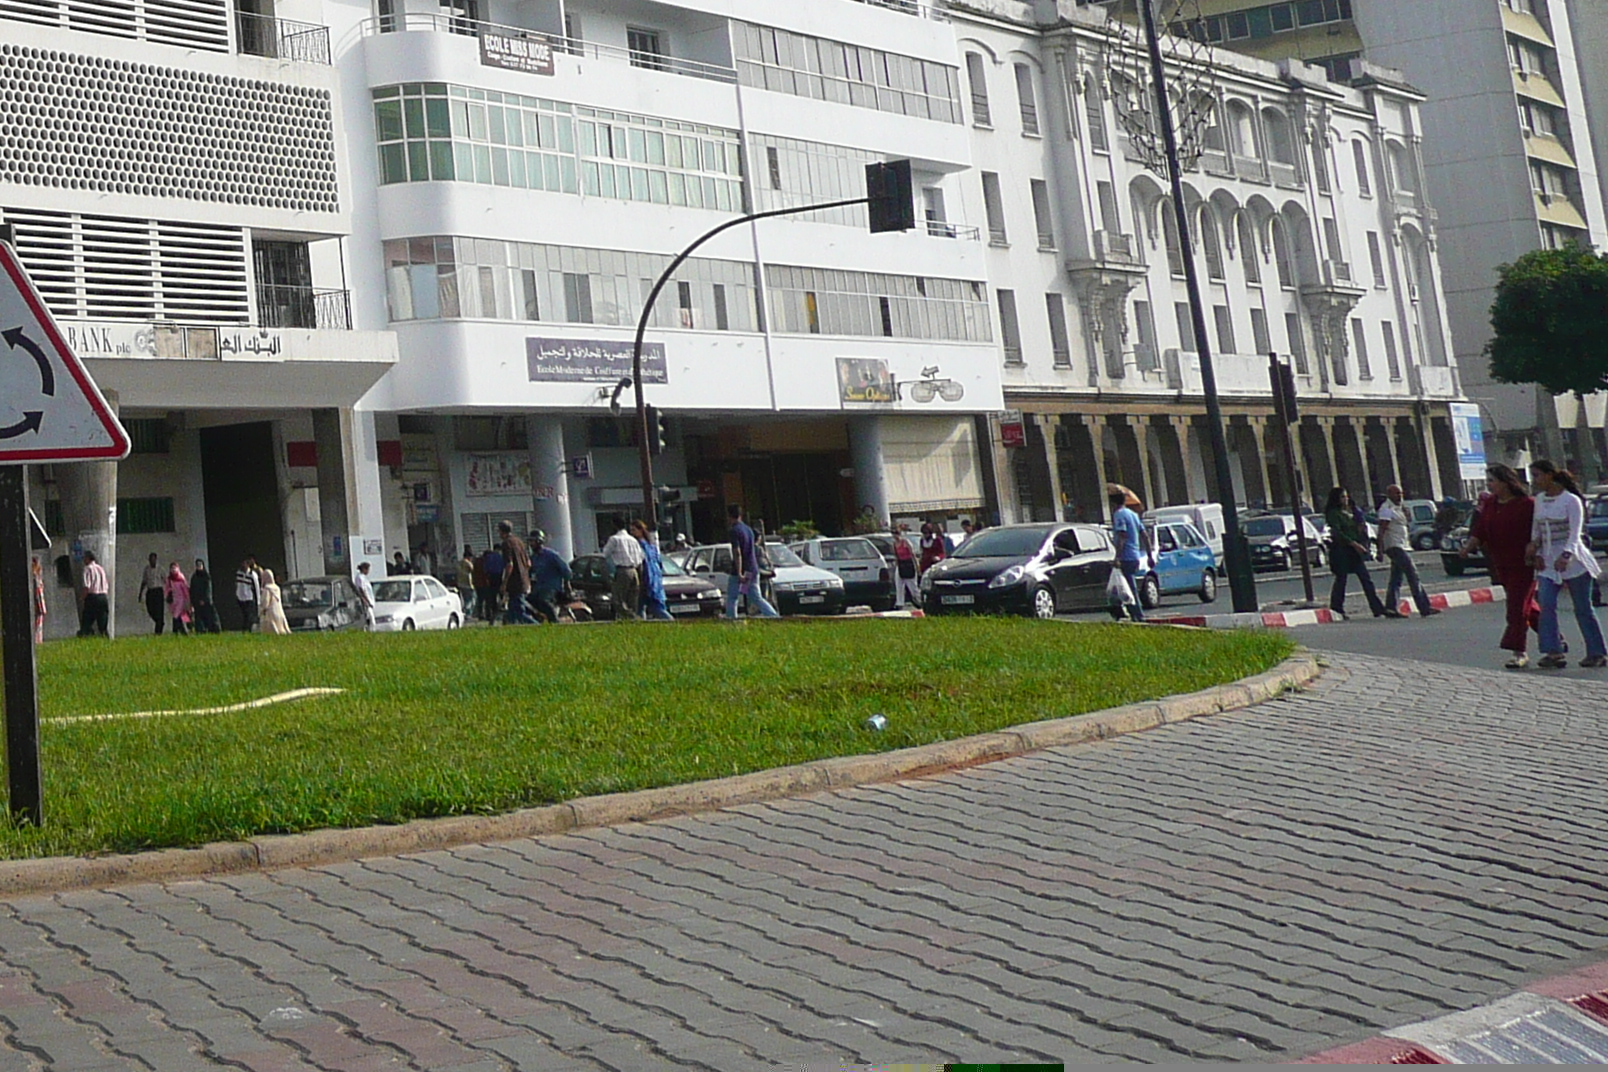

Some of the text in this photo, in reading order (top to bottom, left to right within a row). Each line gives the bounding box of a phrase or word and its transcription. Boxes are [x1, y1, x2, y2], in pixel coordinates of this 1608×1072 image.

[484, 34, 509, 53] ECOLE
[529, 42, 549, 60] MODE
[68, 326, 113, 352] BANK
[244, 334, 281, 357] البنك
